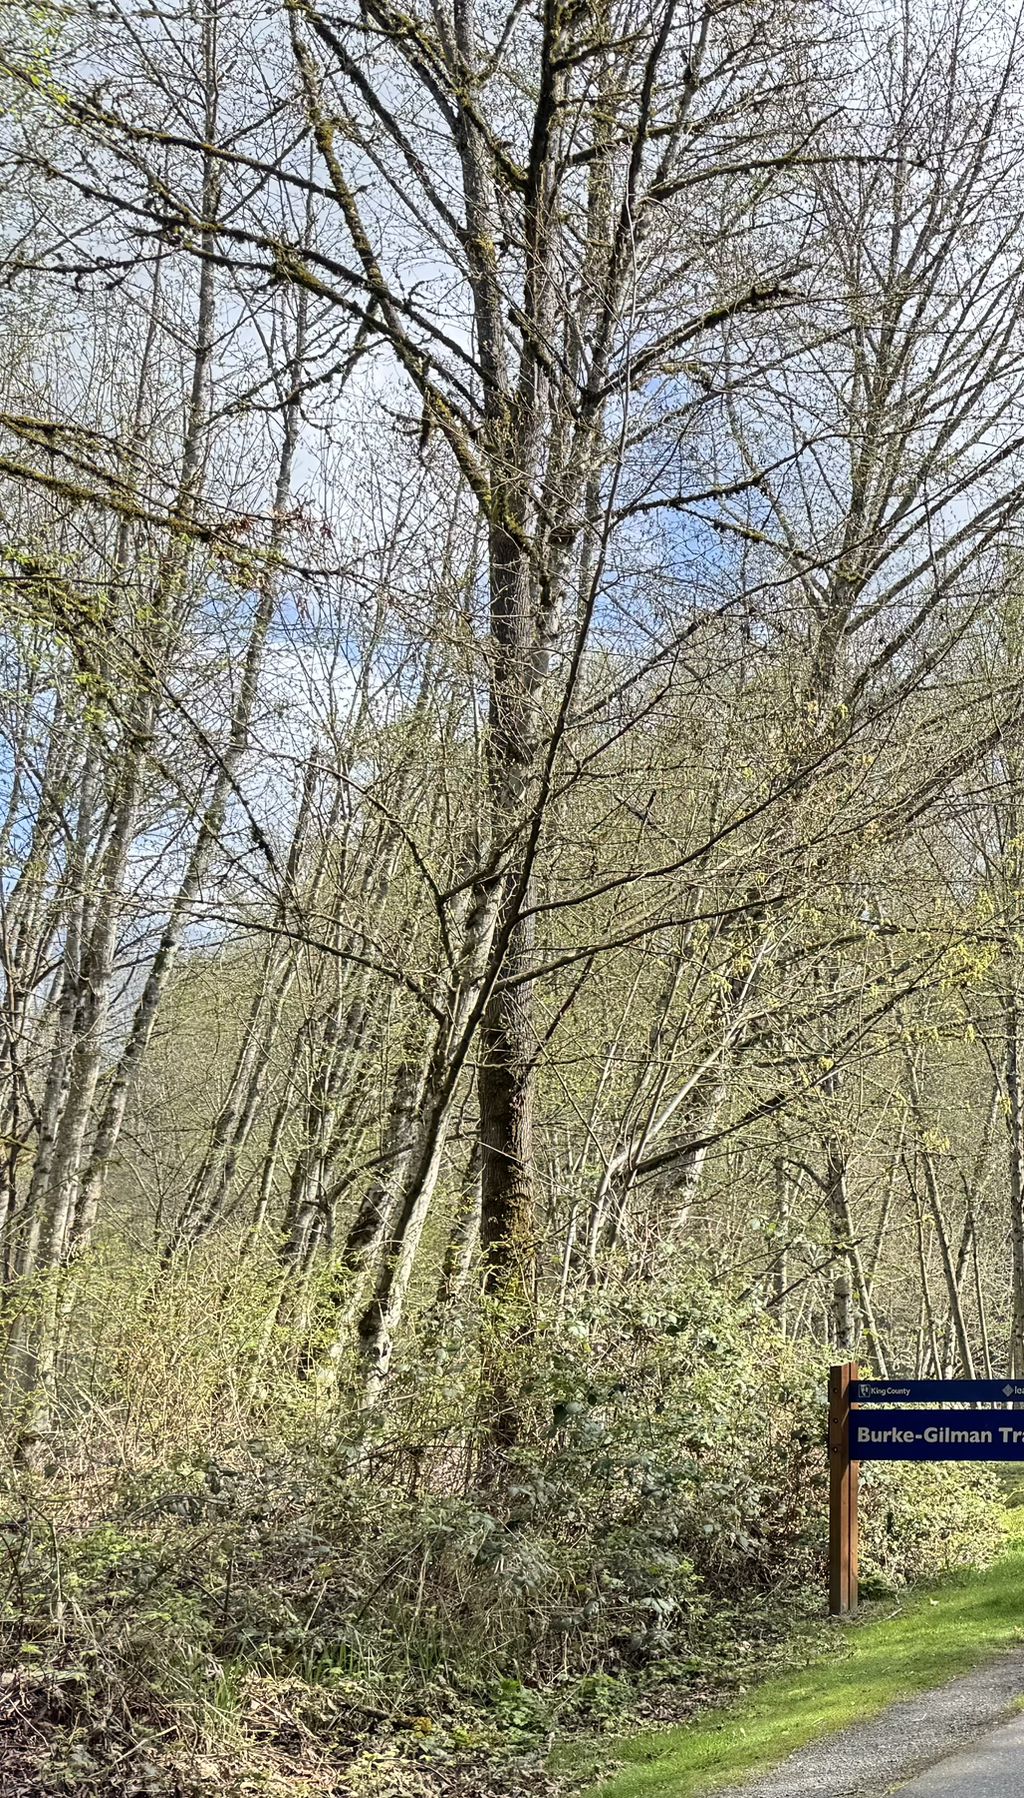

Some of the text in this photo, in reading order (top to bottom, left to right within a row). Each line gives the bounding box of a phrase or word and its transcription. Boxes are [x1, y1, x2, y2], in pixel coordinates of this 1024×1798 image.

[871, 1387, 911, 1396] King County
[857, 1426, 993, 1443] Burke-Gilman
